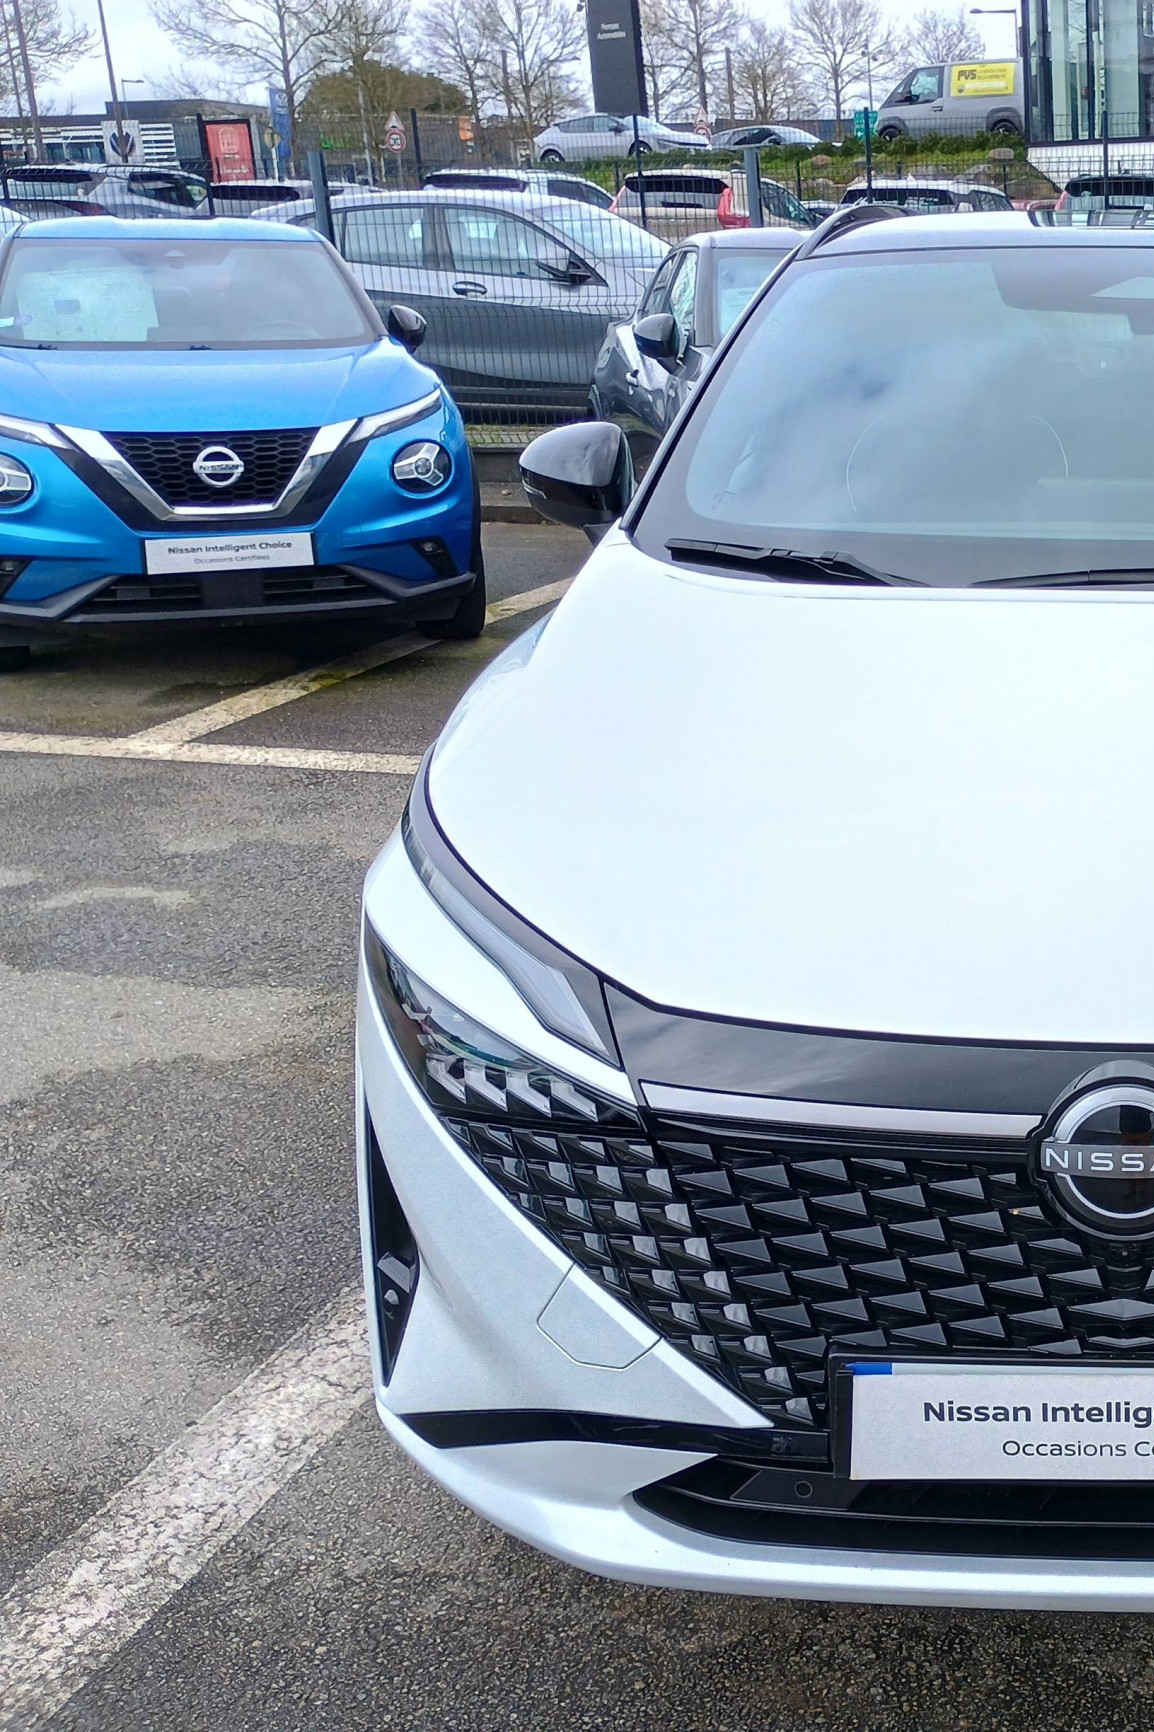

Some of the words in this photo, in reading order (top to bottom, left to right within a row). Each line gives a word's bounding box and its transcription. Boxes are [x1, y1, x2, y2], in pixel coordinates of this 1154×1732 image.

[168, 546, 203, 555] Nissan
[205, 543, 257, 553] Intelligent
[259, 541, 293, 550] Choice
[923, 1401, 1032, 1423] Nissan
[1002, 1440, 1127, 1457] Occasions
